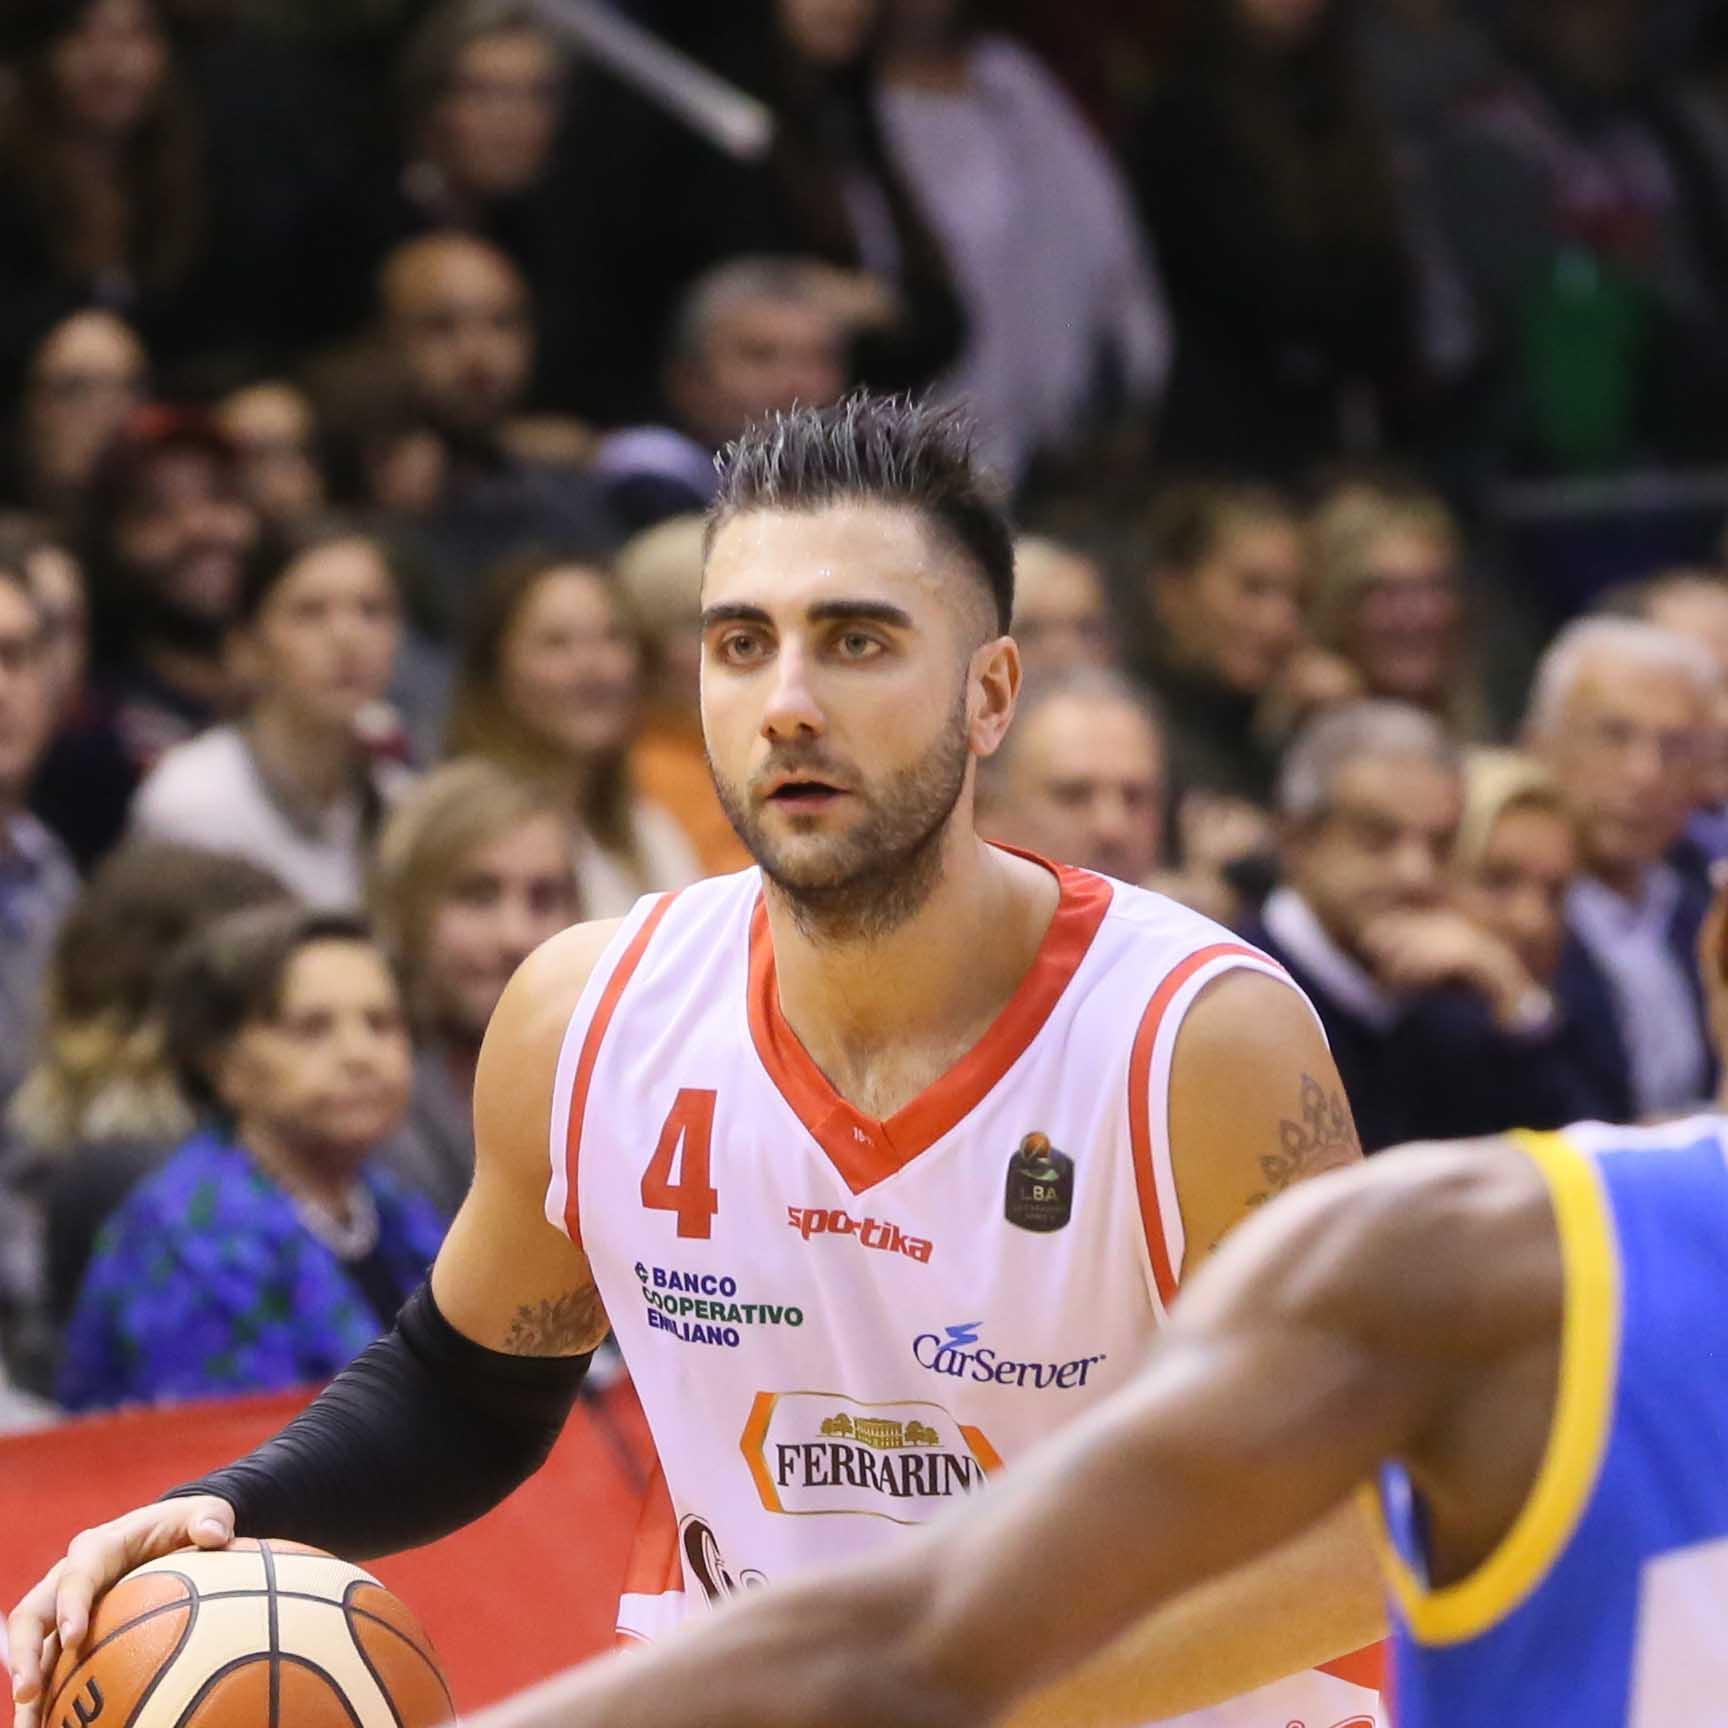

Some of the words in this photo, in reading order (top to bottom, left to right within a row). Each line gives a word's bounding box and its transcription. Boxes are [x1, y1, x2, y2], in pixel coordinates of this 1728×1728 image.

[640, 1087, 718, 1239] 4
[642, 1286, 804, 1327] COOPERATIVO
[652, 1267, 737, 1298] BANCO
[913, 1334, 1098, 1389] CarServer
